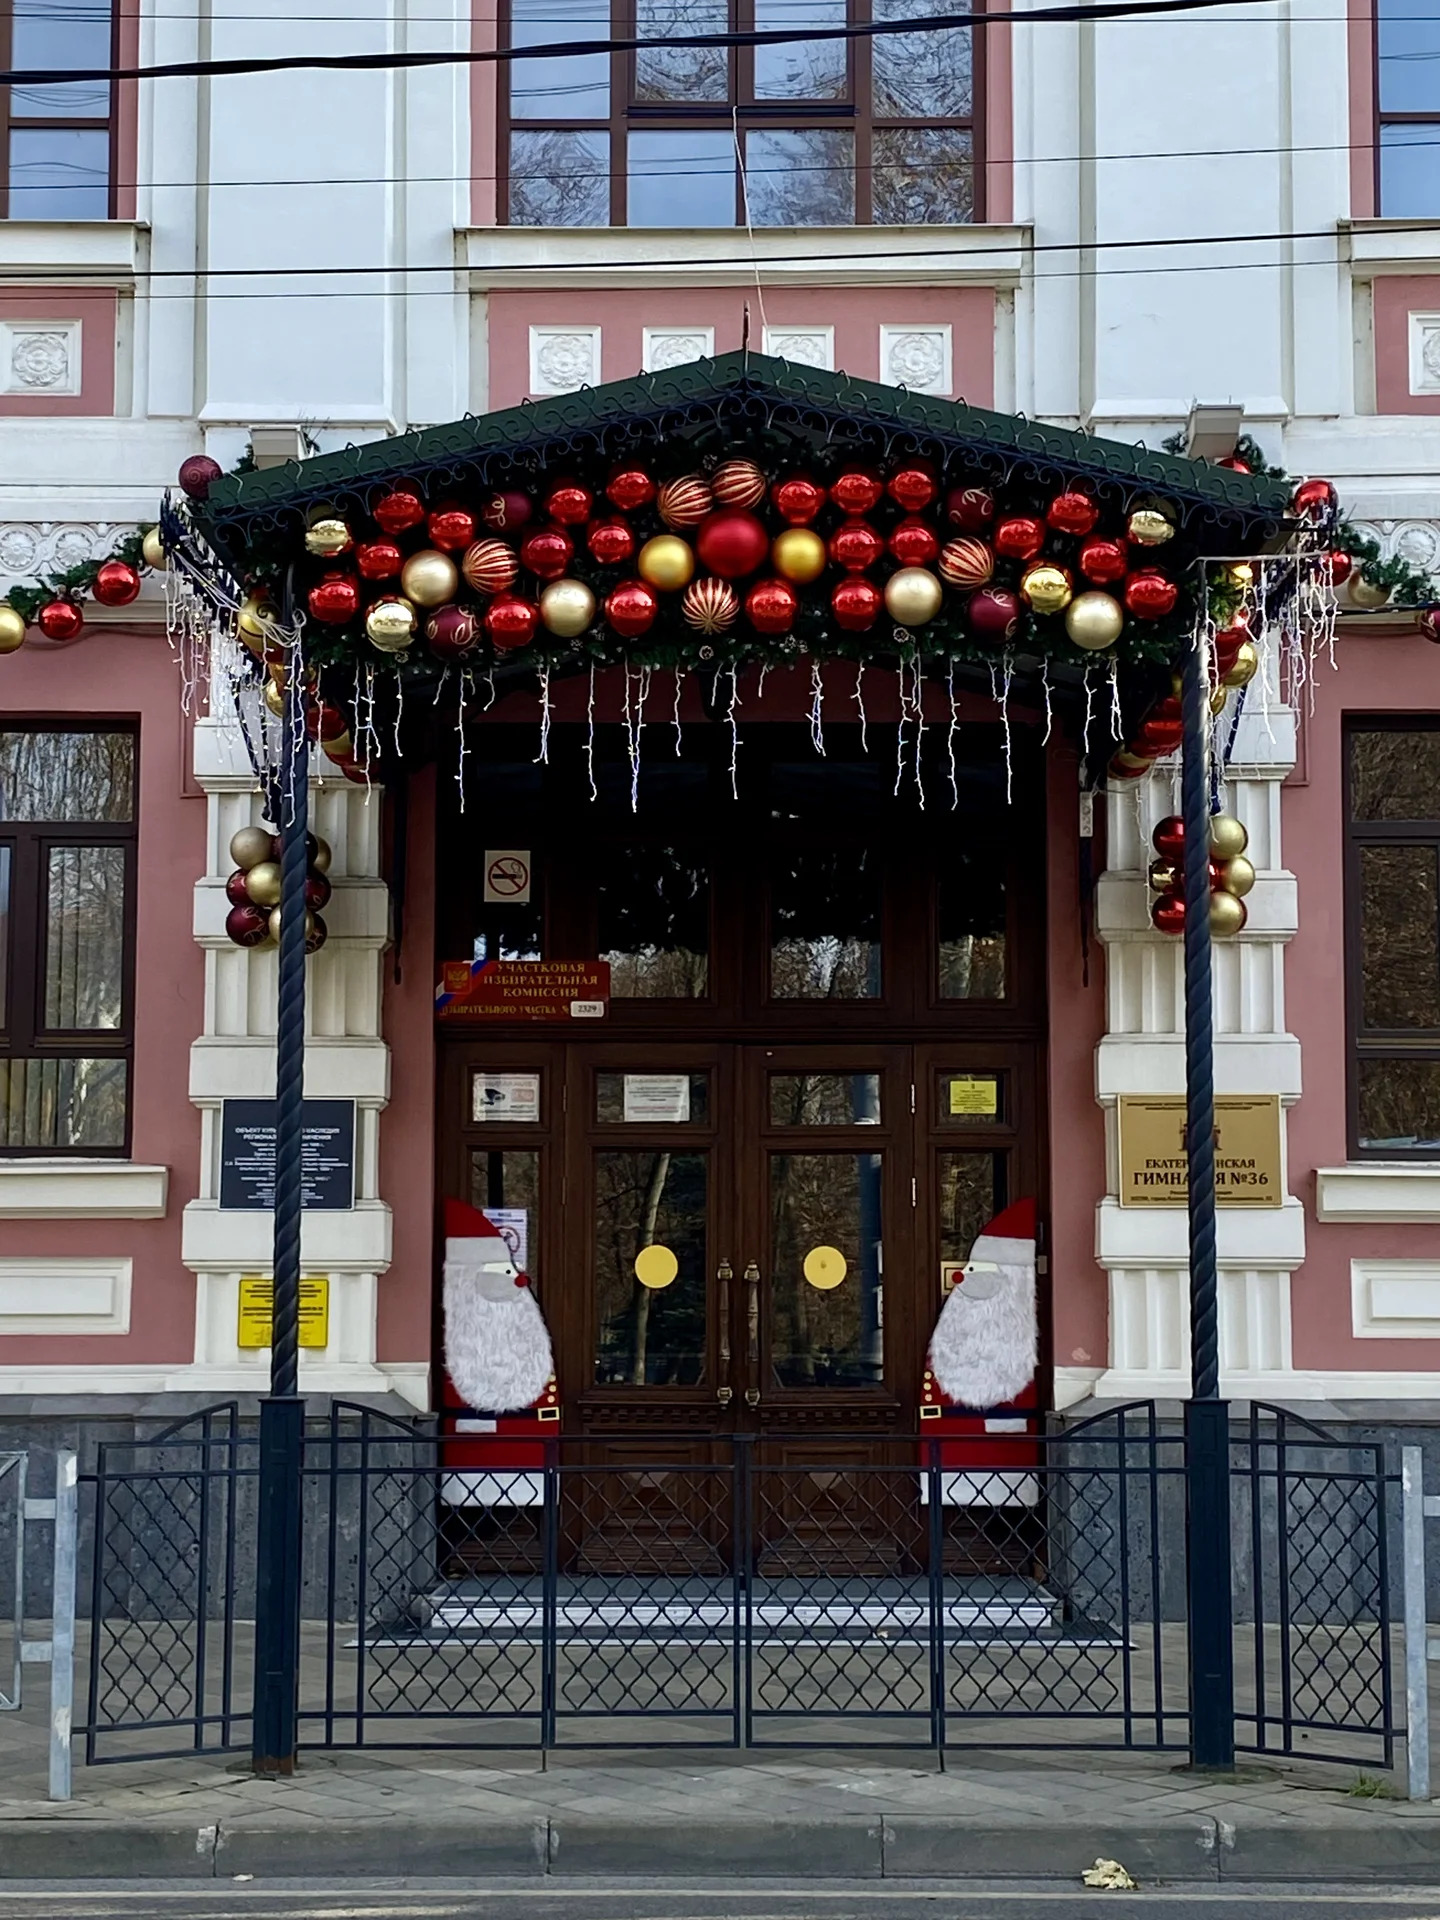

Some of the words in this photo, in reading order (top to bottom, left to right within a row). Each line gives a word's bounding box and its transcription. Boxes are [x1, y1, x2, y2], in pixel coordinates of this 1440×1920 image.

[497, 963, 586, 973] УЧАСТКОВАЯ
[484, 976, 598, 985] ИЗБИРАТЕЛЬНАЯ
[503, 988, 579, 997] КОМИССИЯ
[577, 1004, 598, 1013] 2329
[1230, 1172, 1269, 1186] №36
